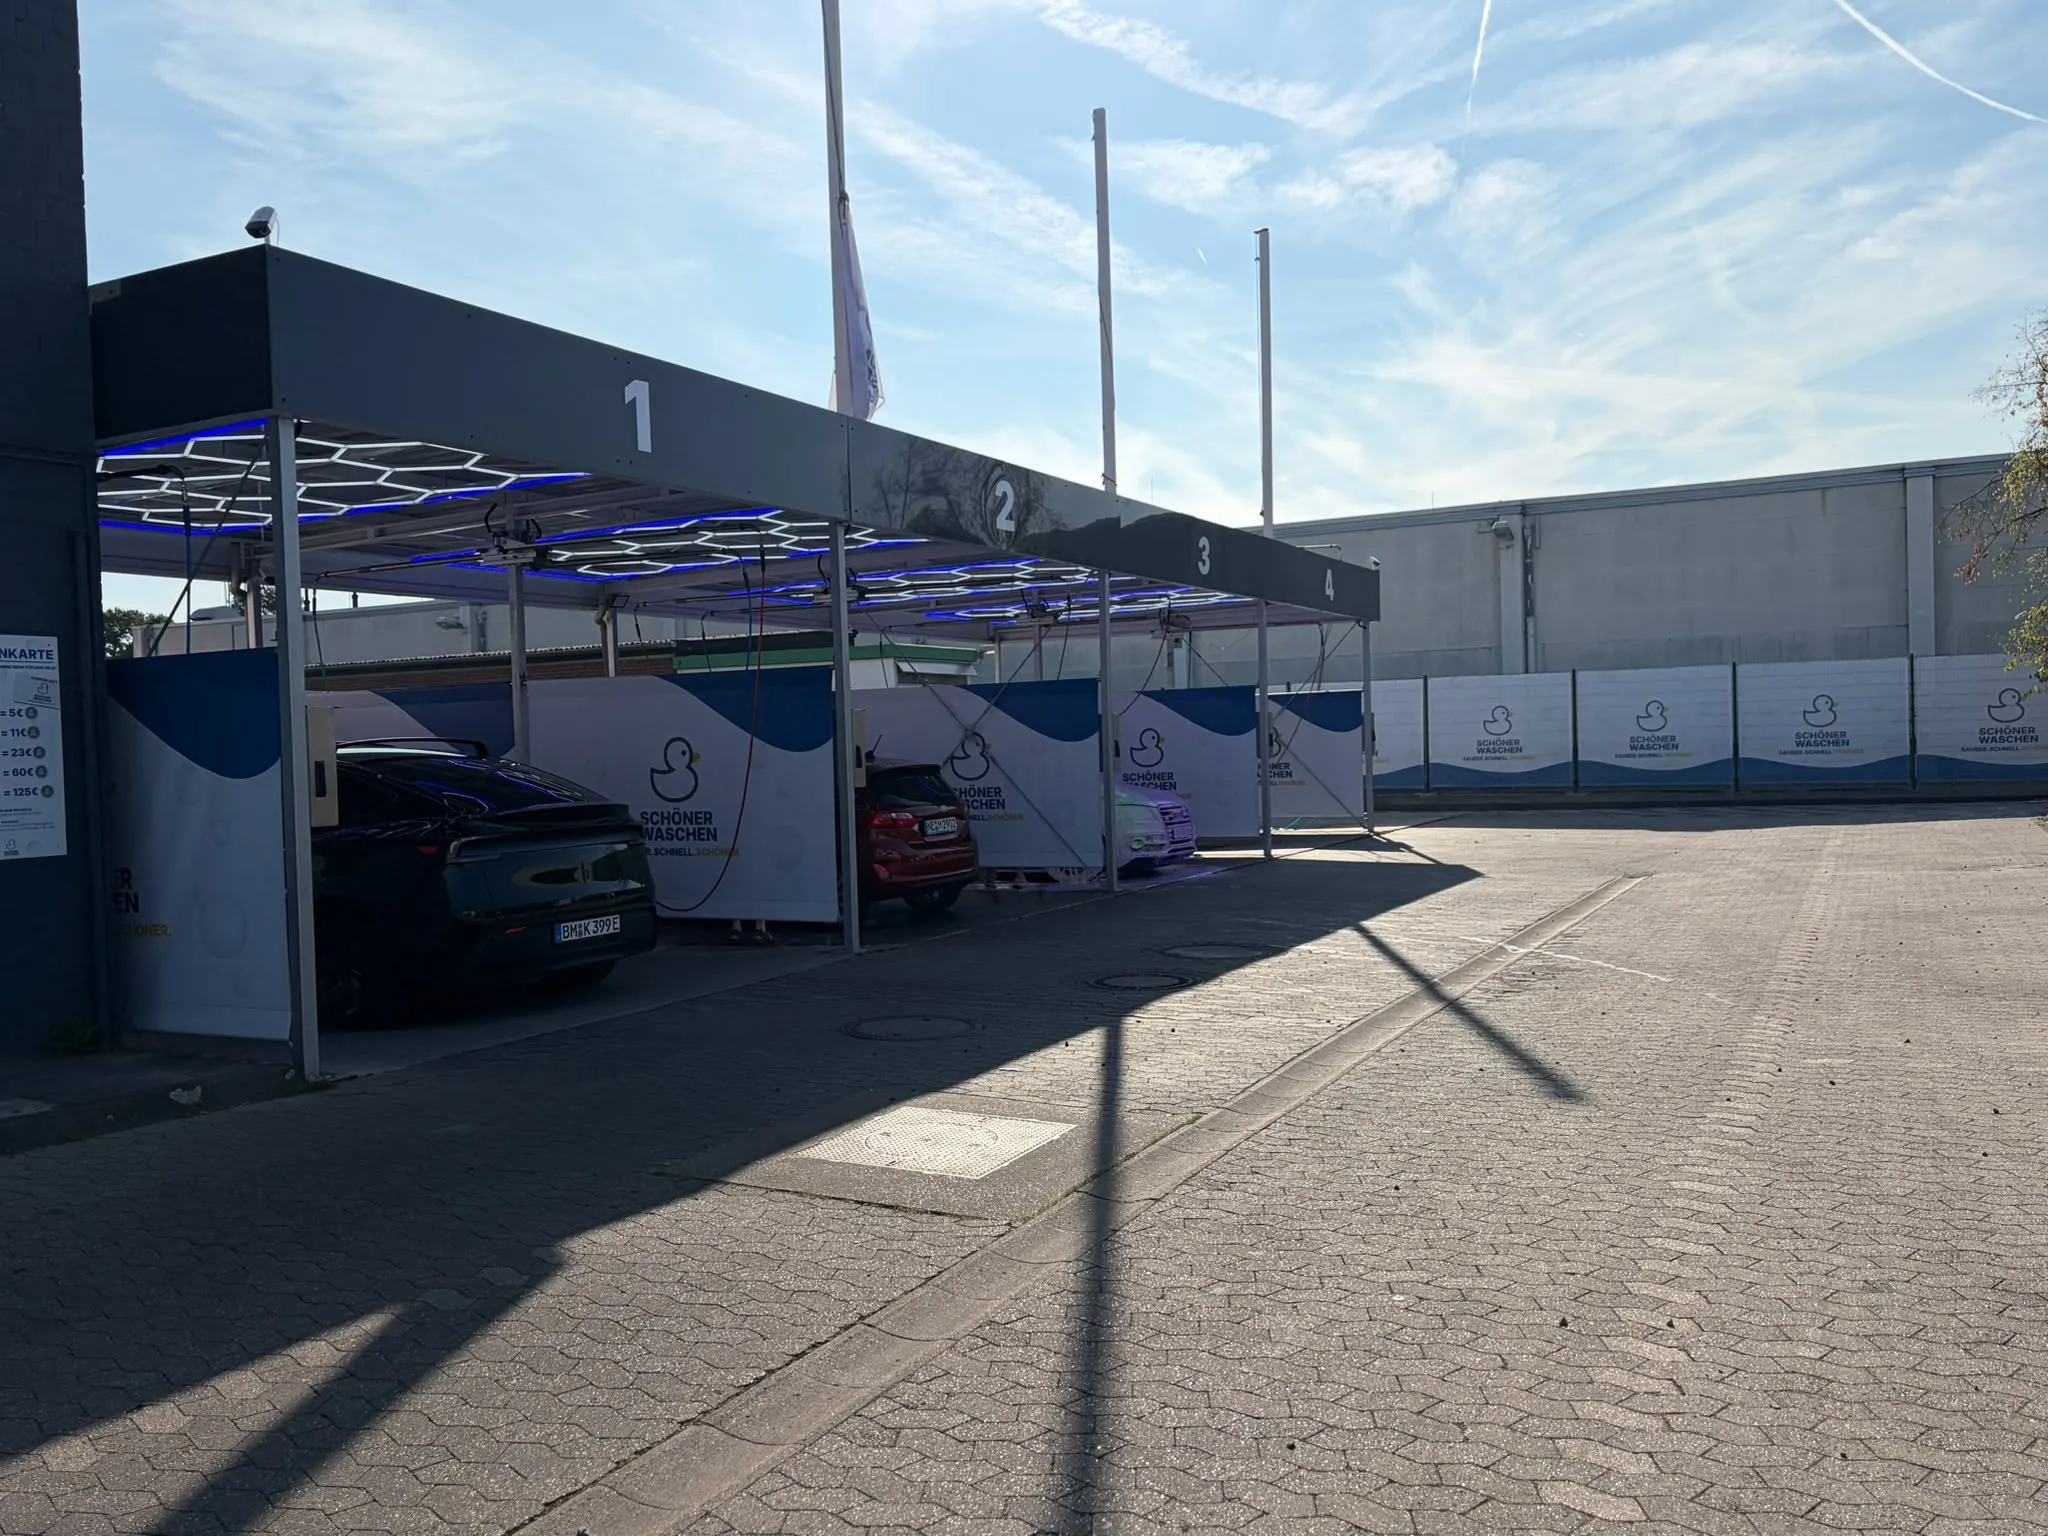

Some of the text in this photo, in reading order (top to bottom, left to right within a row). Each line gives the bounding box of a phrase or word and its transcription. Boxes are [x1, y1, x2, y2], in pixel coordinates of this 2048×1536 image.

[624, 379, 652, 453] 1
[995, 480, 1015, 532] 2
[1197, 536, 1211, 576] 3
[1325, 568, 1335, 602] 4
[9, 708, 24, 717] 5€
[10, 728, 27, 737] 11€
[1795, 730, 1847, 739] SCHÖNER
[1979, 725, 2036, 736] SCHÖNER
[1476, 737, 1520, 746] SCHÖNER
[1629, 734, 1676, 743] SCHÖNER
[1978, 735, 2039, 744] WASCHEN
[1629, 743, 1679, 751] WASCHEN
[1794, 739, 1850, 748] WASCHEN
[11, 748, 32, 757] 23€
[1476, 746, 1523, 754] WASCHEN
[12, 768, 34, 777] 60€
[1122, 770, 1174, 782] SCHÖNER
[13, 788, 38, 797] 125€
[957, 784, 1002, 798] HÖNER
[640, 807, 713, 826] SCHÖNER
[644, 827, 718, 842] WASCHEN
[562, 924, 578, 939] BM
[584, 921, 591, 936] K
